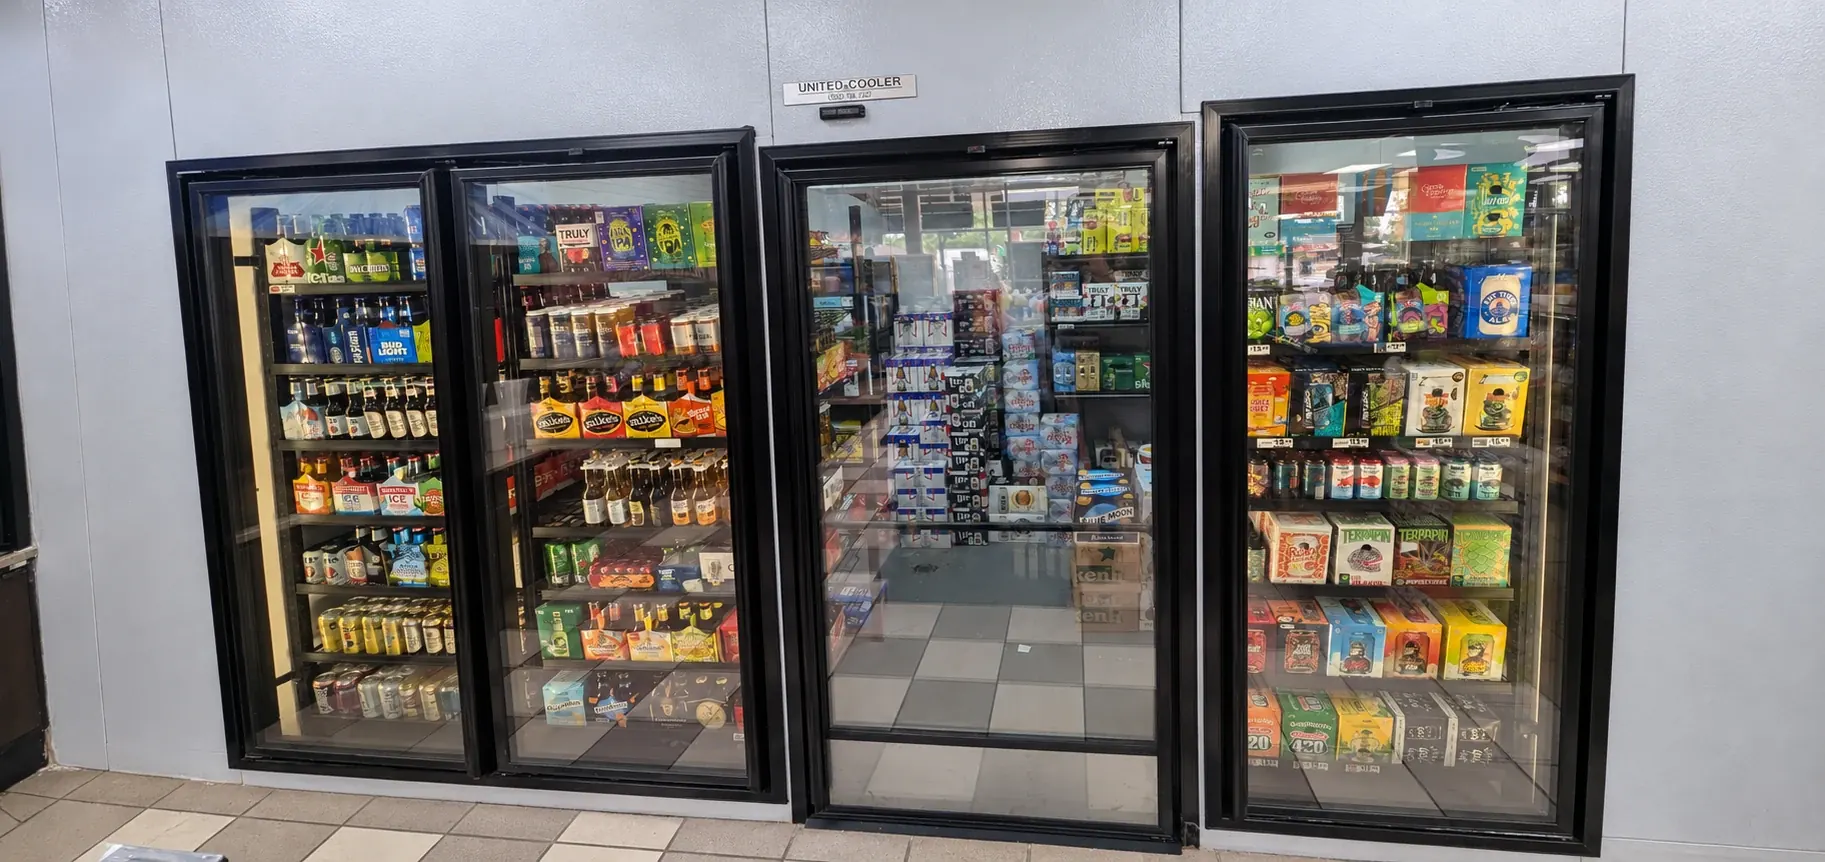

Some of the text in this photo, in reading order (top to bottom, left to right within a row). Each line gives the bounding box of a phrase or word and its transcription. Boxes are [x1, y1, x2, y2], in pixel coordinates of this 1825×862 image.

[799, 77, 901, 92] UNITED COOLER
[559, 229, 590, 240] TRULY
[378, 348, 408, 356] LIGHT
[380, 341, 403, 349] BUD
[1108, 507, 1133, 523] MOON
[1398, 528, 1449, 543] TERRAPIN
[1292, 739, 1324, 754] 420
